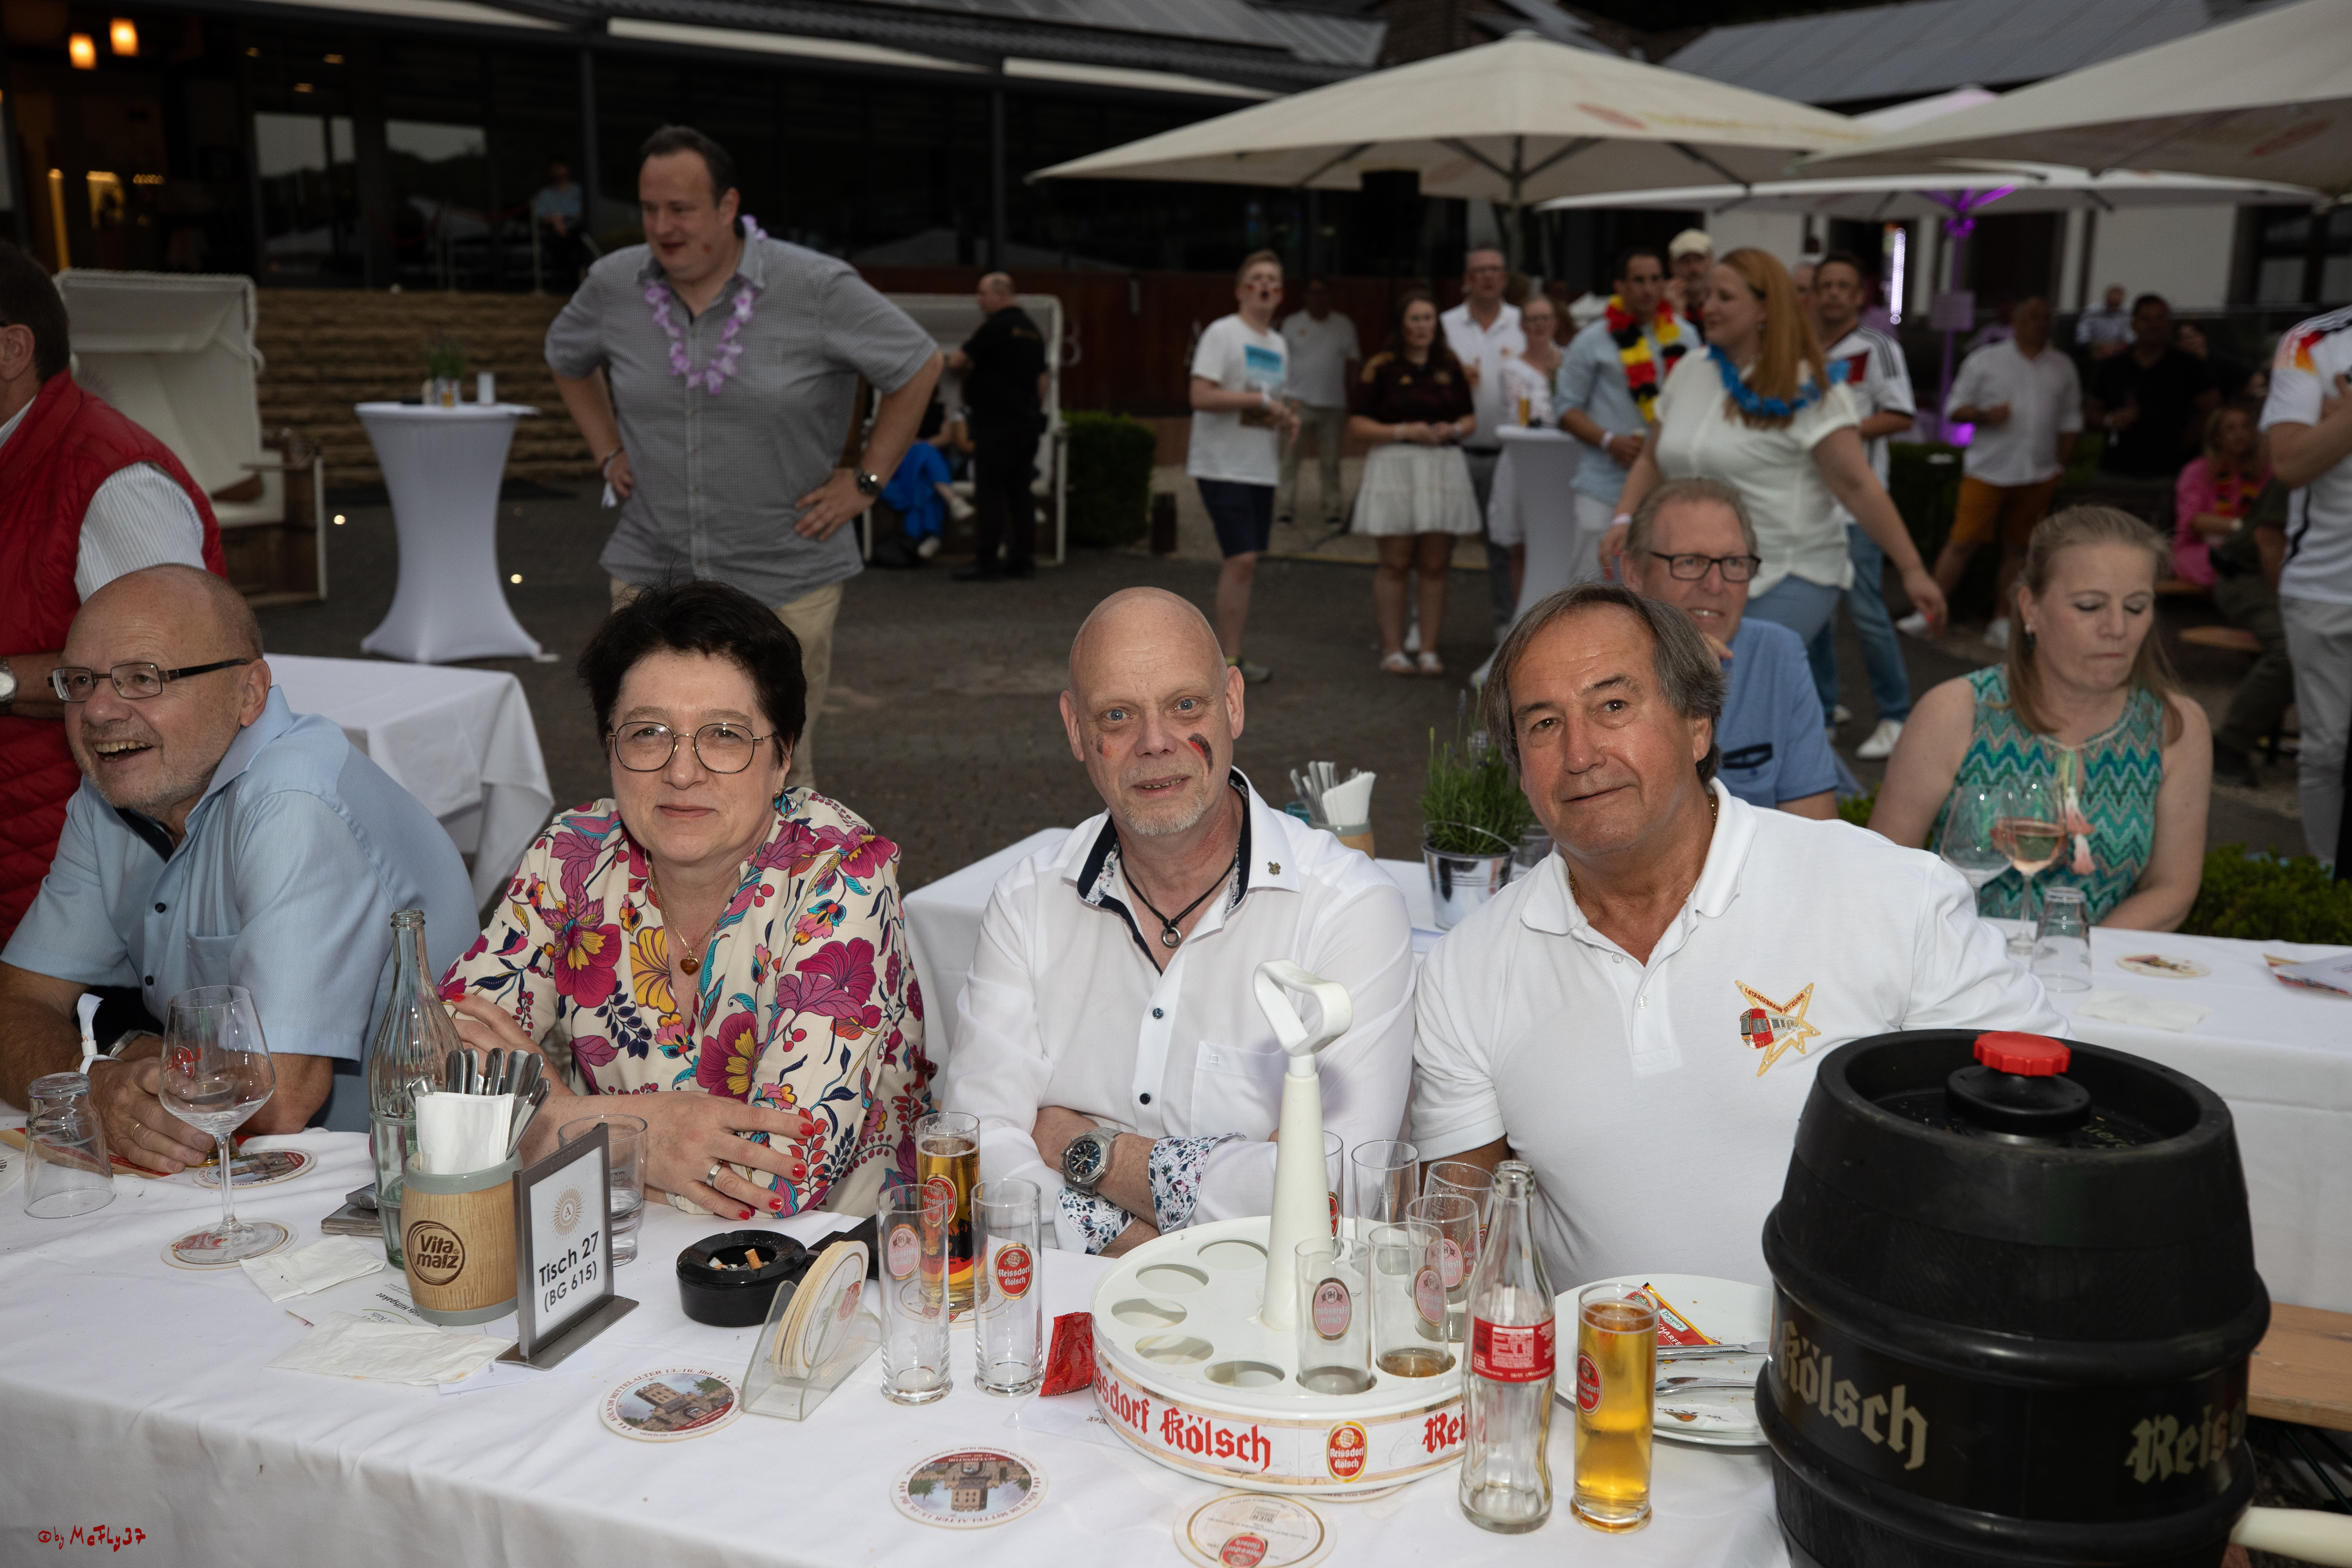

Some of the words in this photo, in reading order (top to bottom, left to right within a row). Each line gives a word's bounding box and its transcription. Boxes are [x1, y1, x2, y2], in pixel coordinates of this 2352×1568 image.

[1783, 993, 1804, 1013] SITZUNG
[564, 1207, 571, 1218] A
[420, 1234, 454, 1254] Vita
[416, 1253, 459, 1269] malz
[539, 1248, 577, 1287] Tisch
[582, 1231, 599, 1259] 27
[997, 1265, 1031, 1277] Reissdorf
[544, 1282, 567, 1313] (BG
[571, 1260, 597, 1290] 615)
[1004, 1276, 1026, 1286] Kölsch
[376, 1292, 409, 1312] Hilfspaket
[1662, 1311, 1684, 1329] Develey
[610, 1370, 662, 1399] MITTELALTER
[1778, 1320, 1928, 1470] Kölsch
[1094, 1367, 1150, 1434] ssdorf
[1159, 1407, 1271, 1472] Kölsch
[1329, 1446, 1364, 1458] Reissdorf
[1334, 1457, 1359, 1469] Kölsch
[934, 1511, 1009, 1523] MITTELALTER
